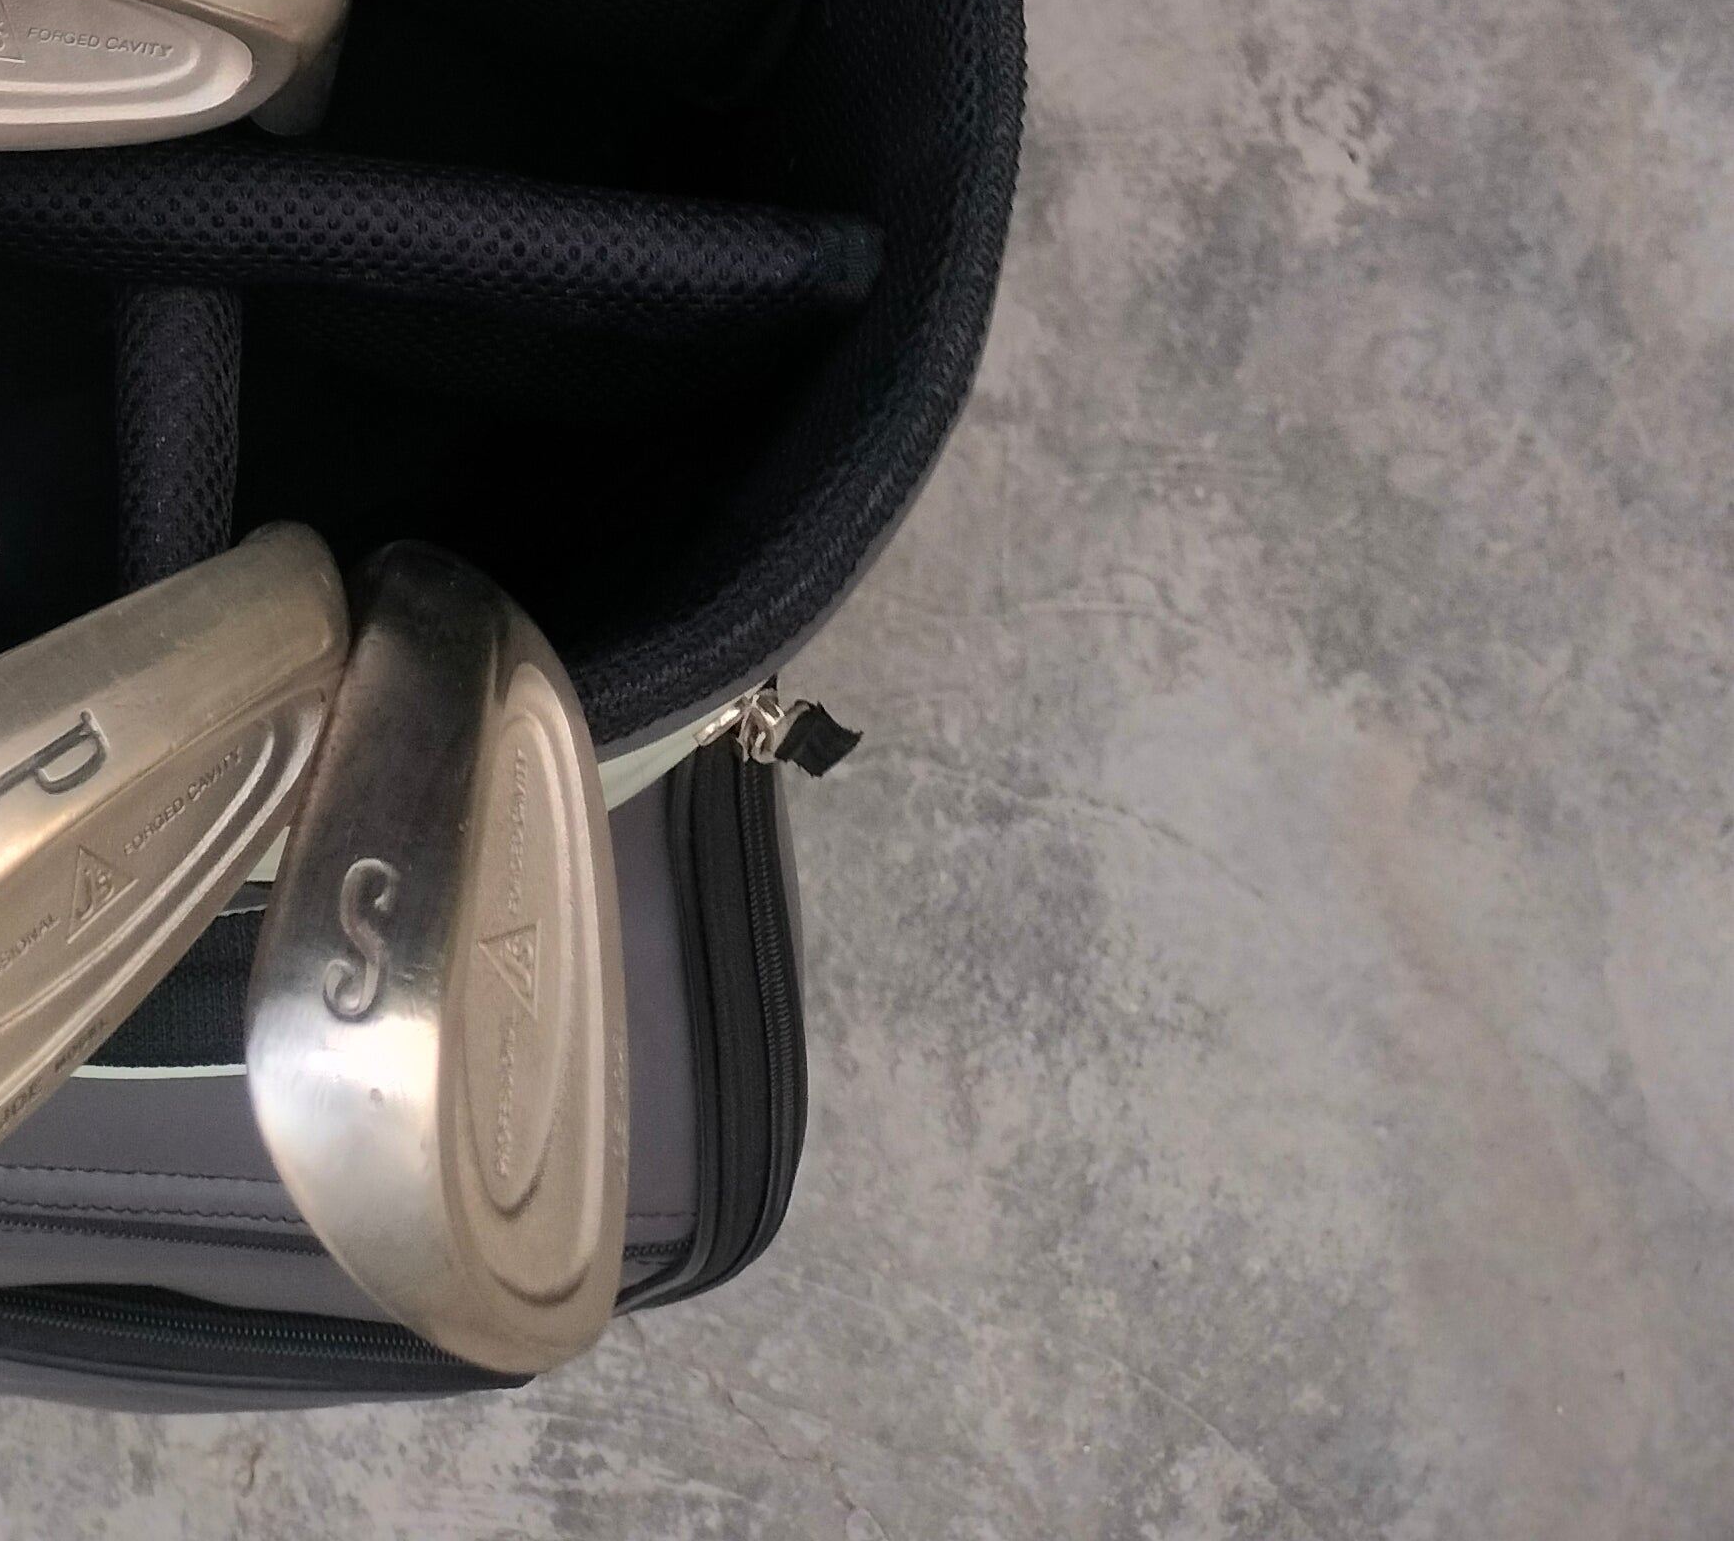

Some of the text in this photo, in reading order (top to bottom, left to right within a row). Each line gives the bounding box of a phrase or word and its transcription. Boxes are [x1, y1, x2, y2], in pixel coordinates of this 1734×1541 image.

[26, 26, 174, 59] FORGED CAVITY
[320, 856, 398, 1024] S
